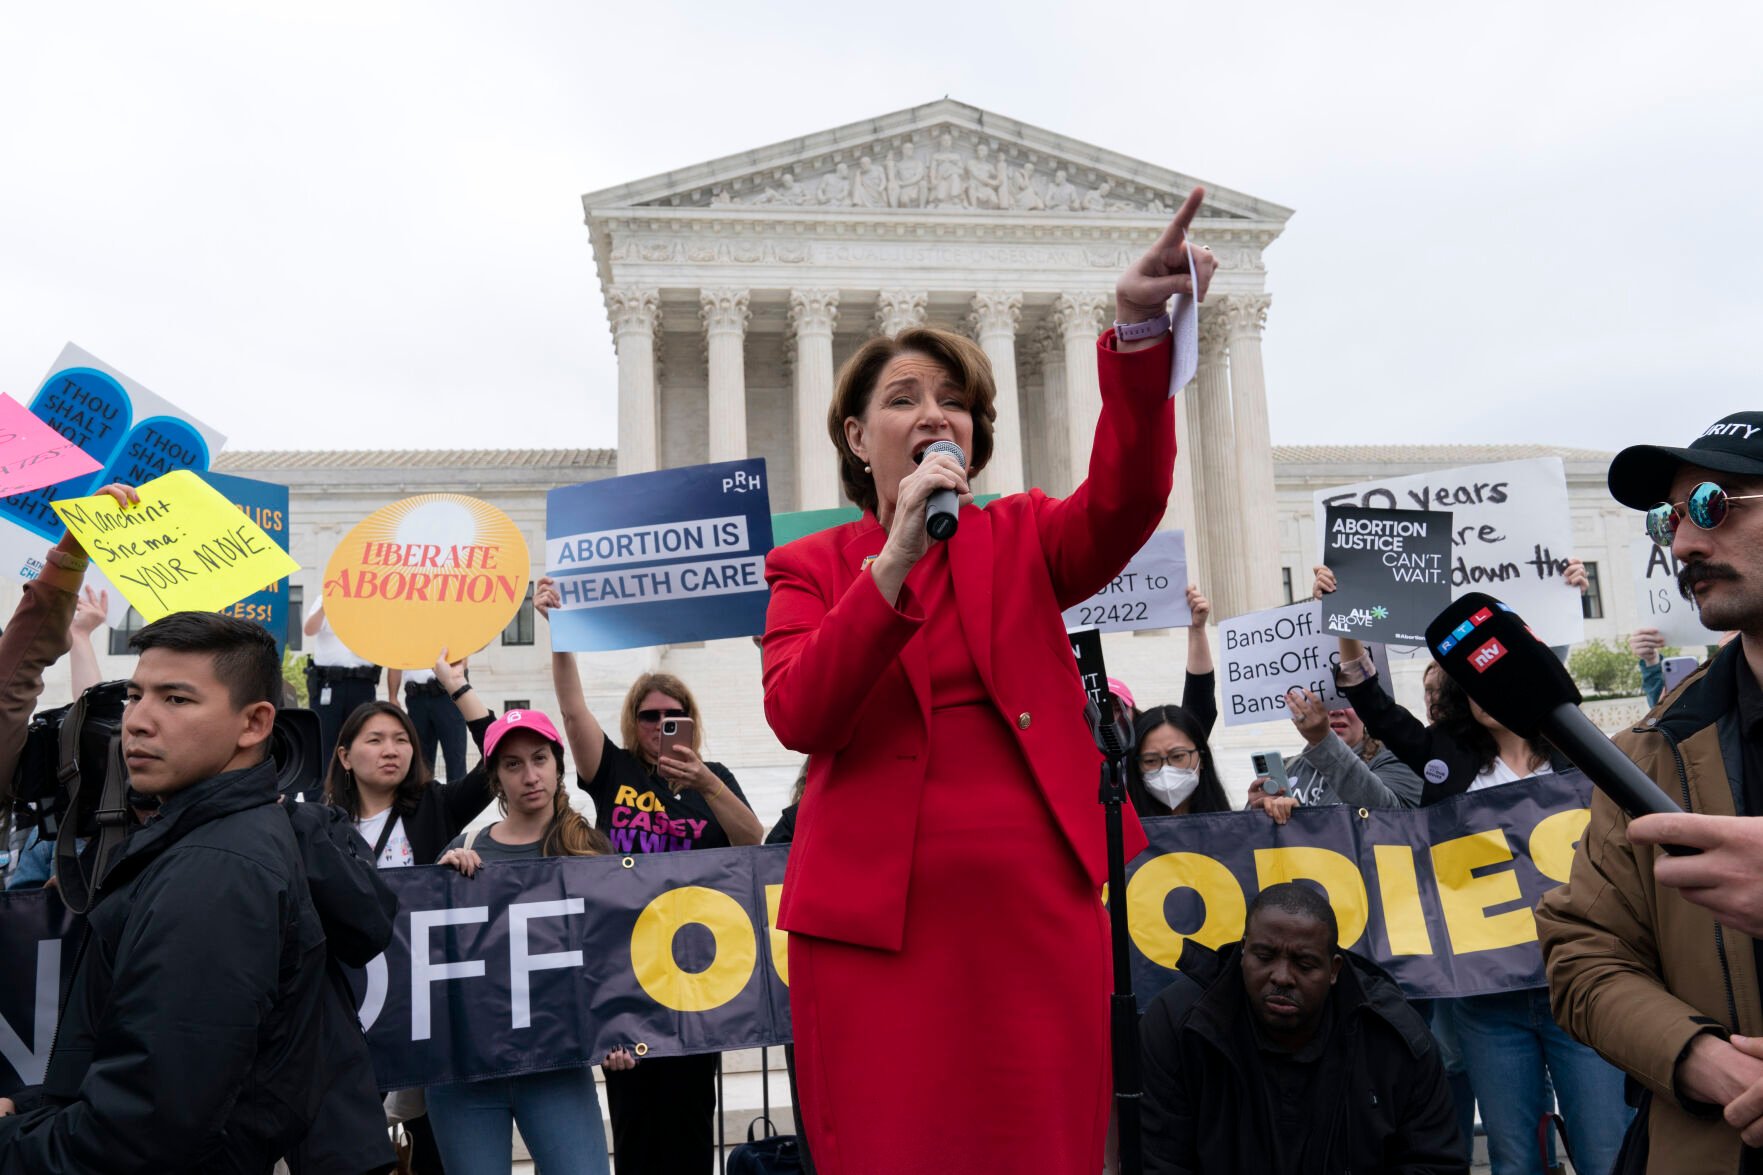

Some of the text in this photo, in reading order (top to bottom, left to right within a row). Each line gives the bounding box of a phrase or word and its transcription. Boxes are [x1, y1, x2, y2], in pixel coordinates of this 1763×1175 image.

[62, 378, 119, 421] THOU
[44, 394, 112, 439] SHALT
[144, 427, 197, 466] THOU
[722, 470, 761, 493] PRH
[1408, 482, 1509, 511] years
[1332, 518, 1427, 537] ABORTION
[361, 542, 500, 570] LIBERATE
[557, 522, 740, 564] ABORTION IS
[1332, 534, 1403, 551] JUSTICE
[120, 525, 272, 611] YOUR MOVE.
[1382, 552, 1442, 569] CAN'T
[1451, 556, 1520, 587] down
[323, 568, 520, 604] ABORTION
[559, 562, 759, 605] HEALTH CARE
[1145, 574, 1169, 591] to
[1392, 568, 1446, 584] WAIT.
[1080, 602, 1149, 626] 22422
[1350, 608, 1373, 620] ALL
[1649, 588, 1671, 615] IS
[1328, 613, 1373, 627] ABOVE
[1328, 622, 1351, 632] ALL
[1474, 643, 1500, 667] ntv
[612, 806, 708, 839] CASEY
